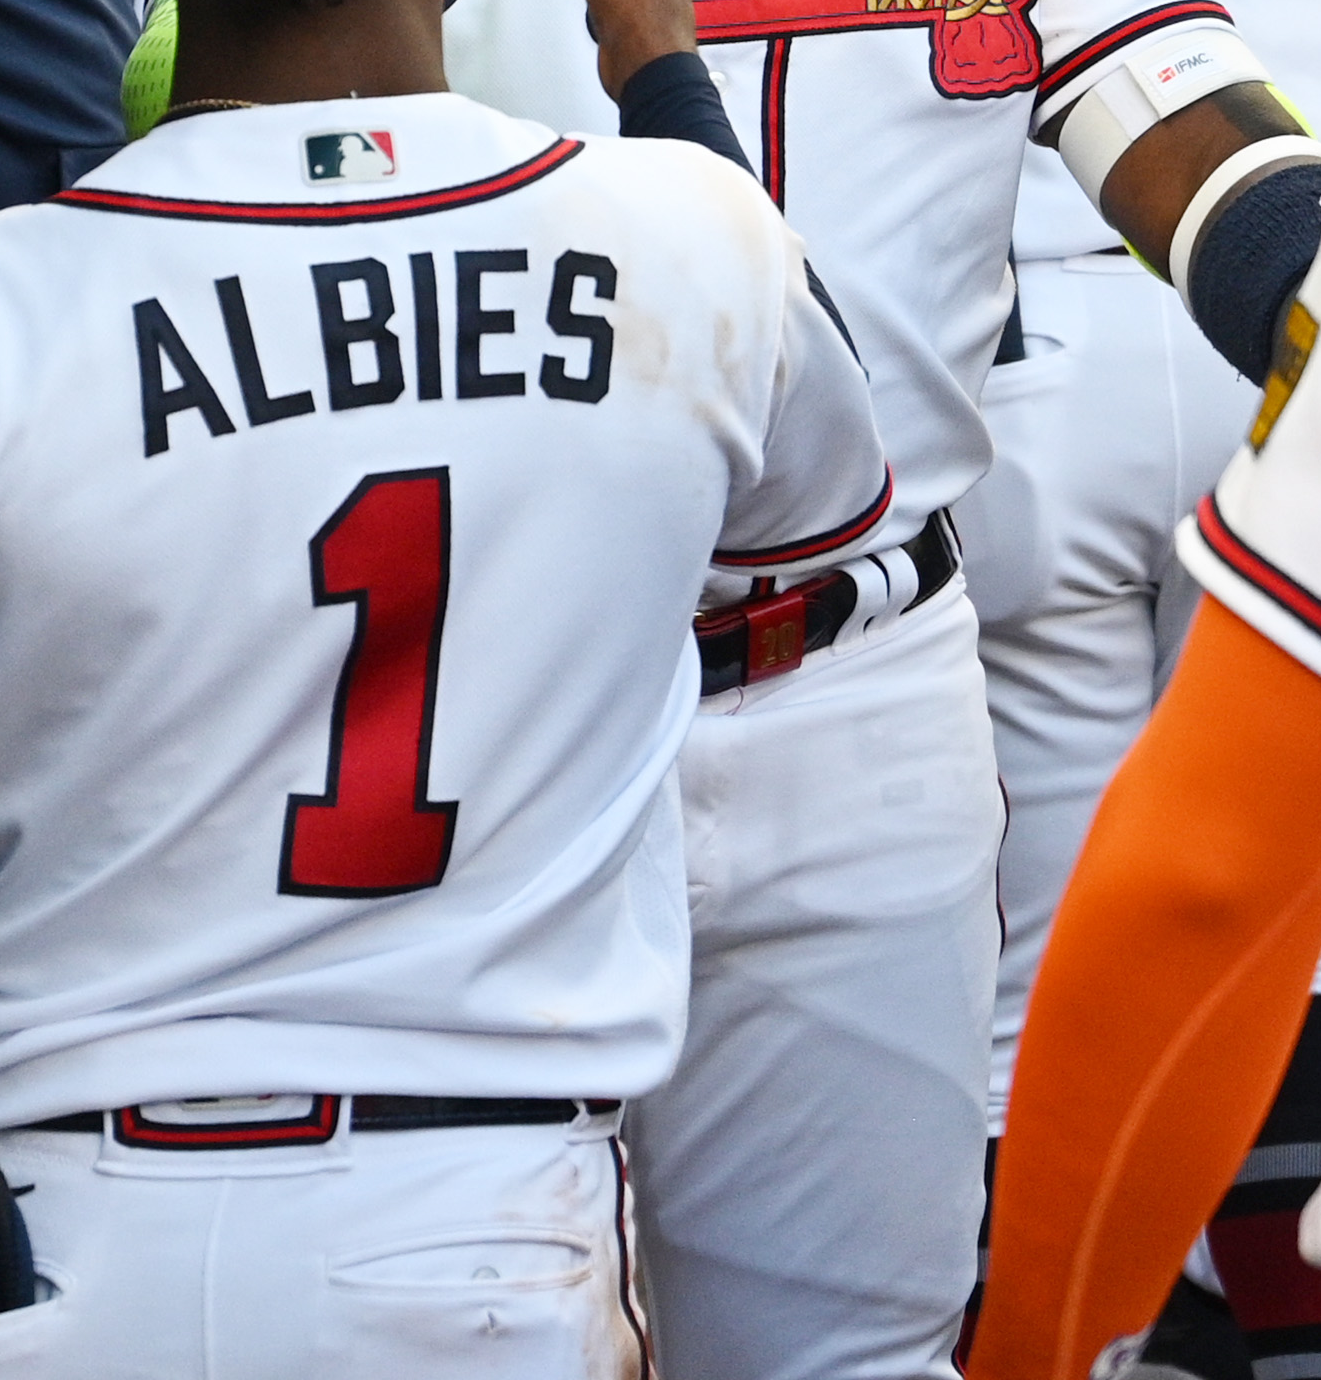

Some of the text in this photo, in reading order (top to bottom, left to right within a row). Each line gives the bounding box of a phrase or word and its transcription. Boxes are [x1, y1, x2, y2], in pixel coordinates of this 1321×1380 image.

[132, 248, 618, 458] ALBIES
[278, 465, 459, 899] 1
[760, 621, 797, 669] 20
